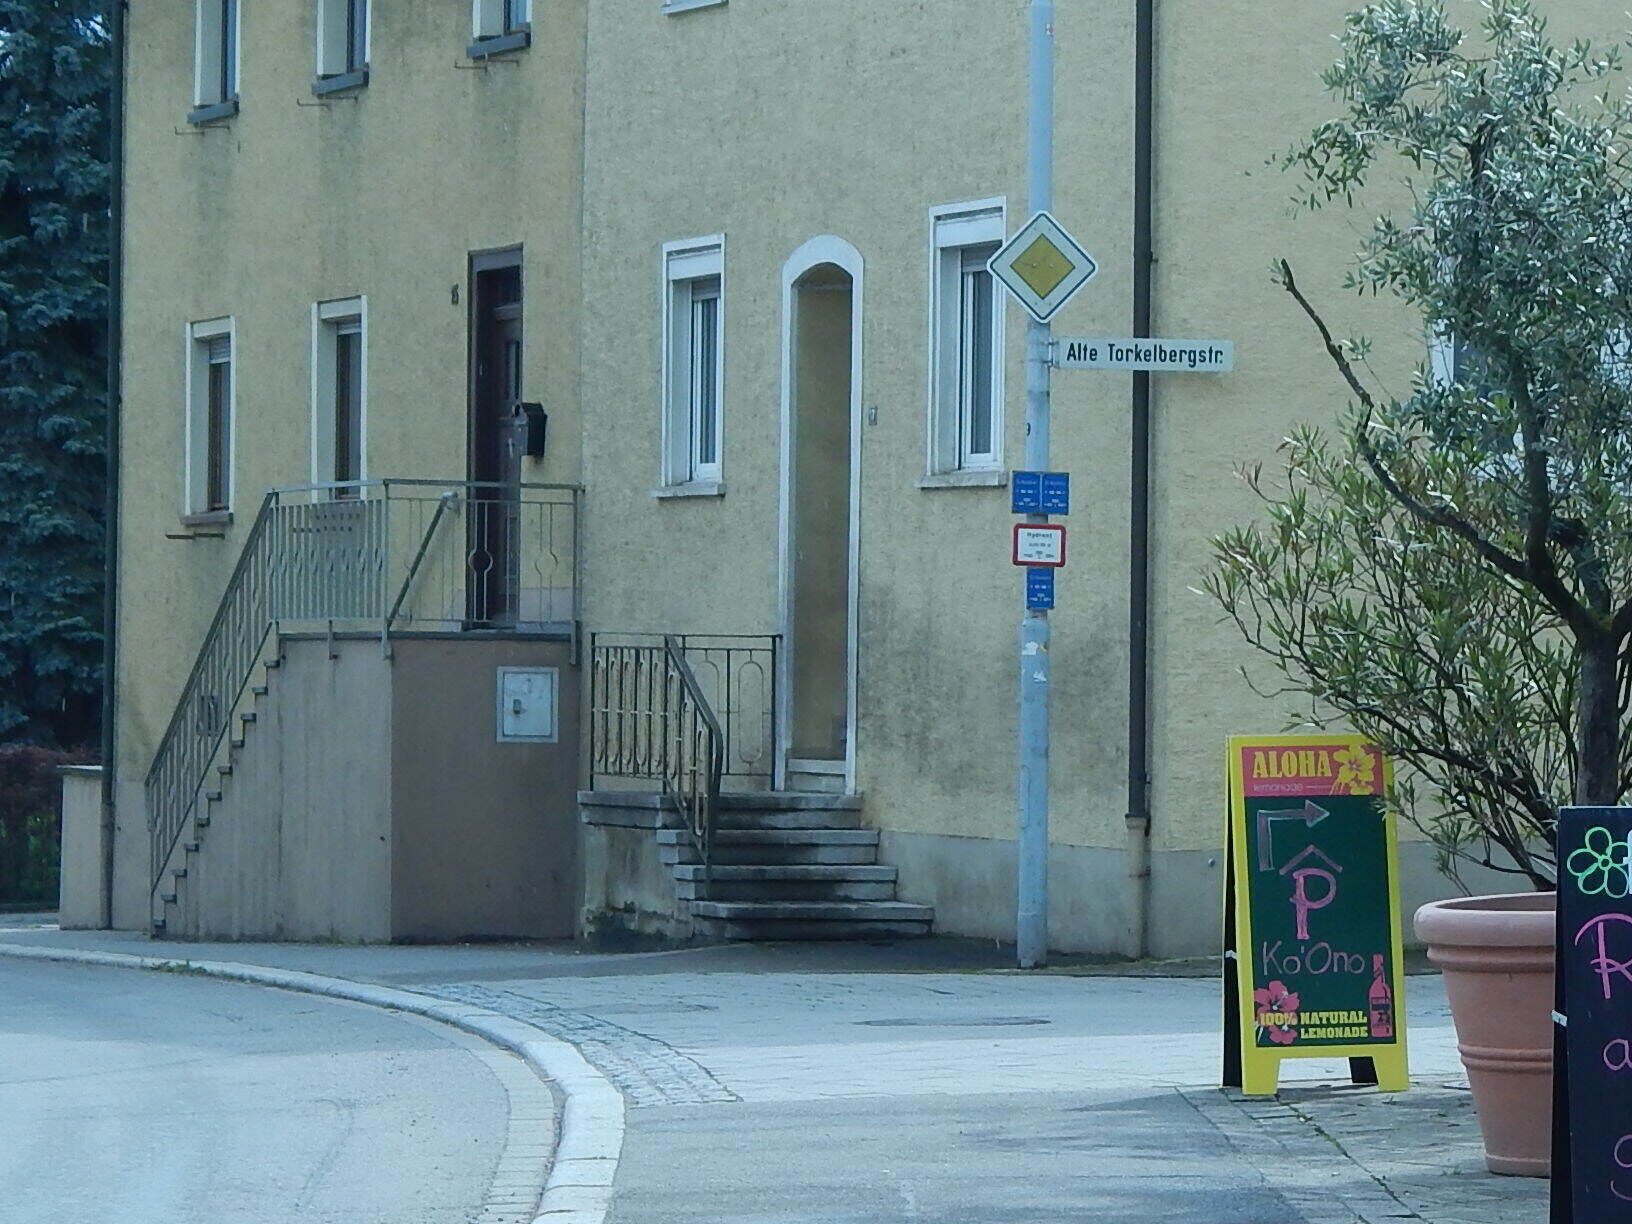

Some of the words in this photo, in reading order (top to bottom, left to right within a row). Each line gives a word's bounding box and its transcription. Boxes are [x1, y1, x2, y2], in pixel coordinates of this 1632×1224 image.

[1066, 342, 1098, 362] Alte
[1107, 343, 1224, 368] Torkelbergstr.
[1252, 750, 1332, 779] ALOHA
[1259, 1012, 1298, 1027] 100%
[1300, 1010, 1368, 1025] NATURAL
[1300, 1025, 1369, 1039] LEMONADE
